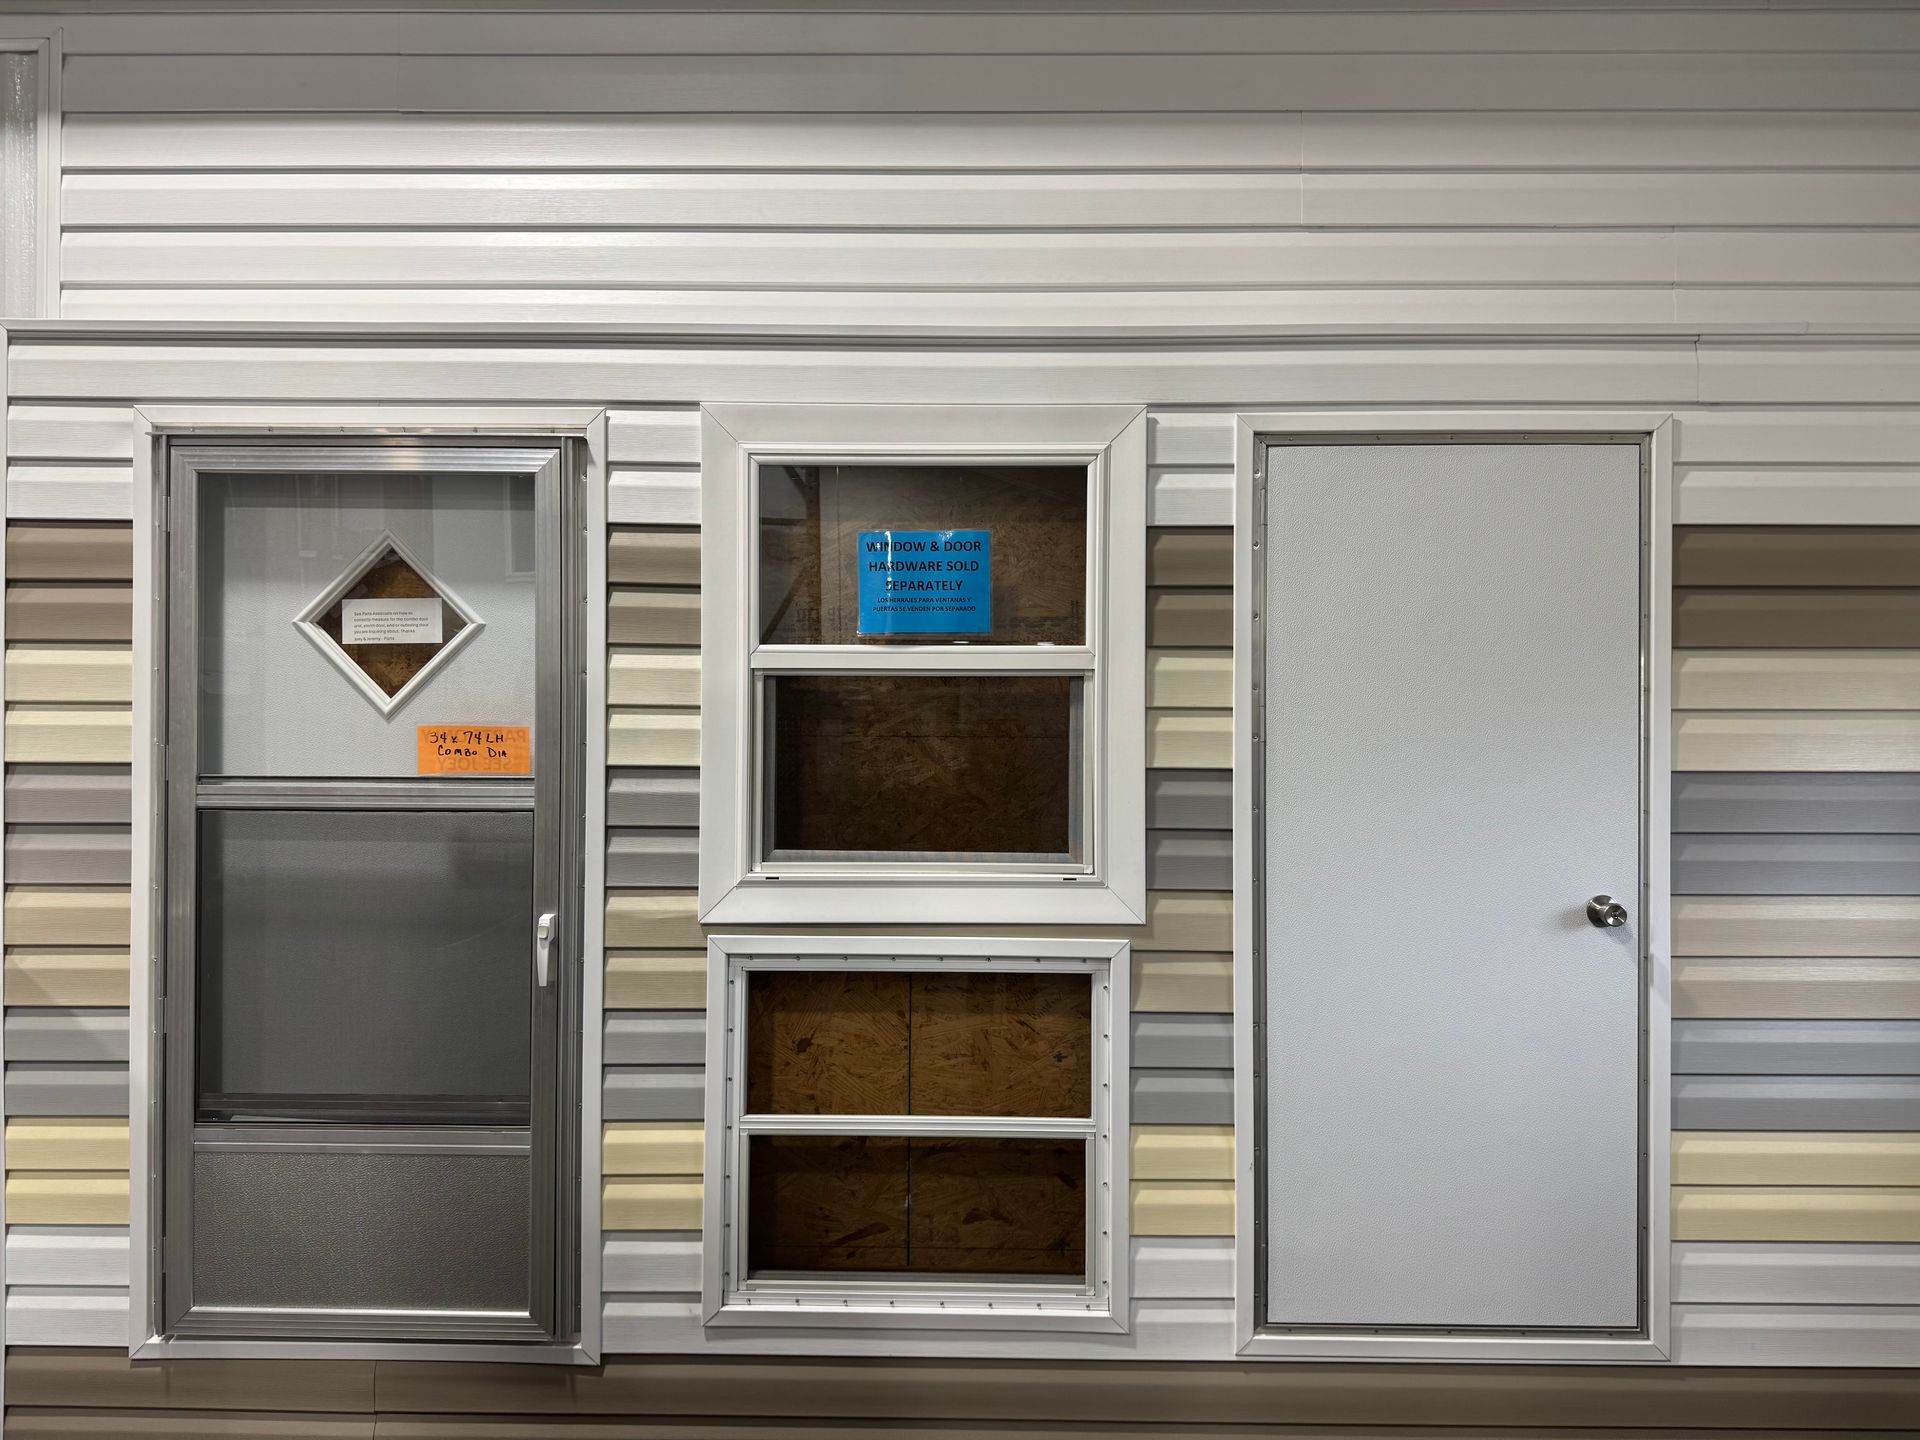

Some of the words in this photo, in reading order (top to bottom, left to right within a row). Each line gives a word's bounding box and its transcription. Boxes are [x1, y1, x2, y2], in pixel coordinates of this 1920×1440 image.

[866, 541, 926, 552] WINDOW
[930, 541, 940, 552] &
[944, 541, 981, 552] DOOR
[869, 561, 942, 572] HARDWARE
[946, 560, 979, 572] SOLD
[885, 581, 963, 592] SEPARATELY
[430, 732, 447, 744] 34
[464, 731, 481, 745] 74
[486, 733, 503, 743] LH
